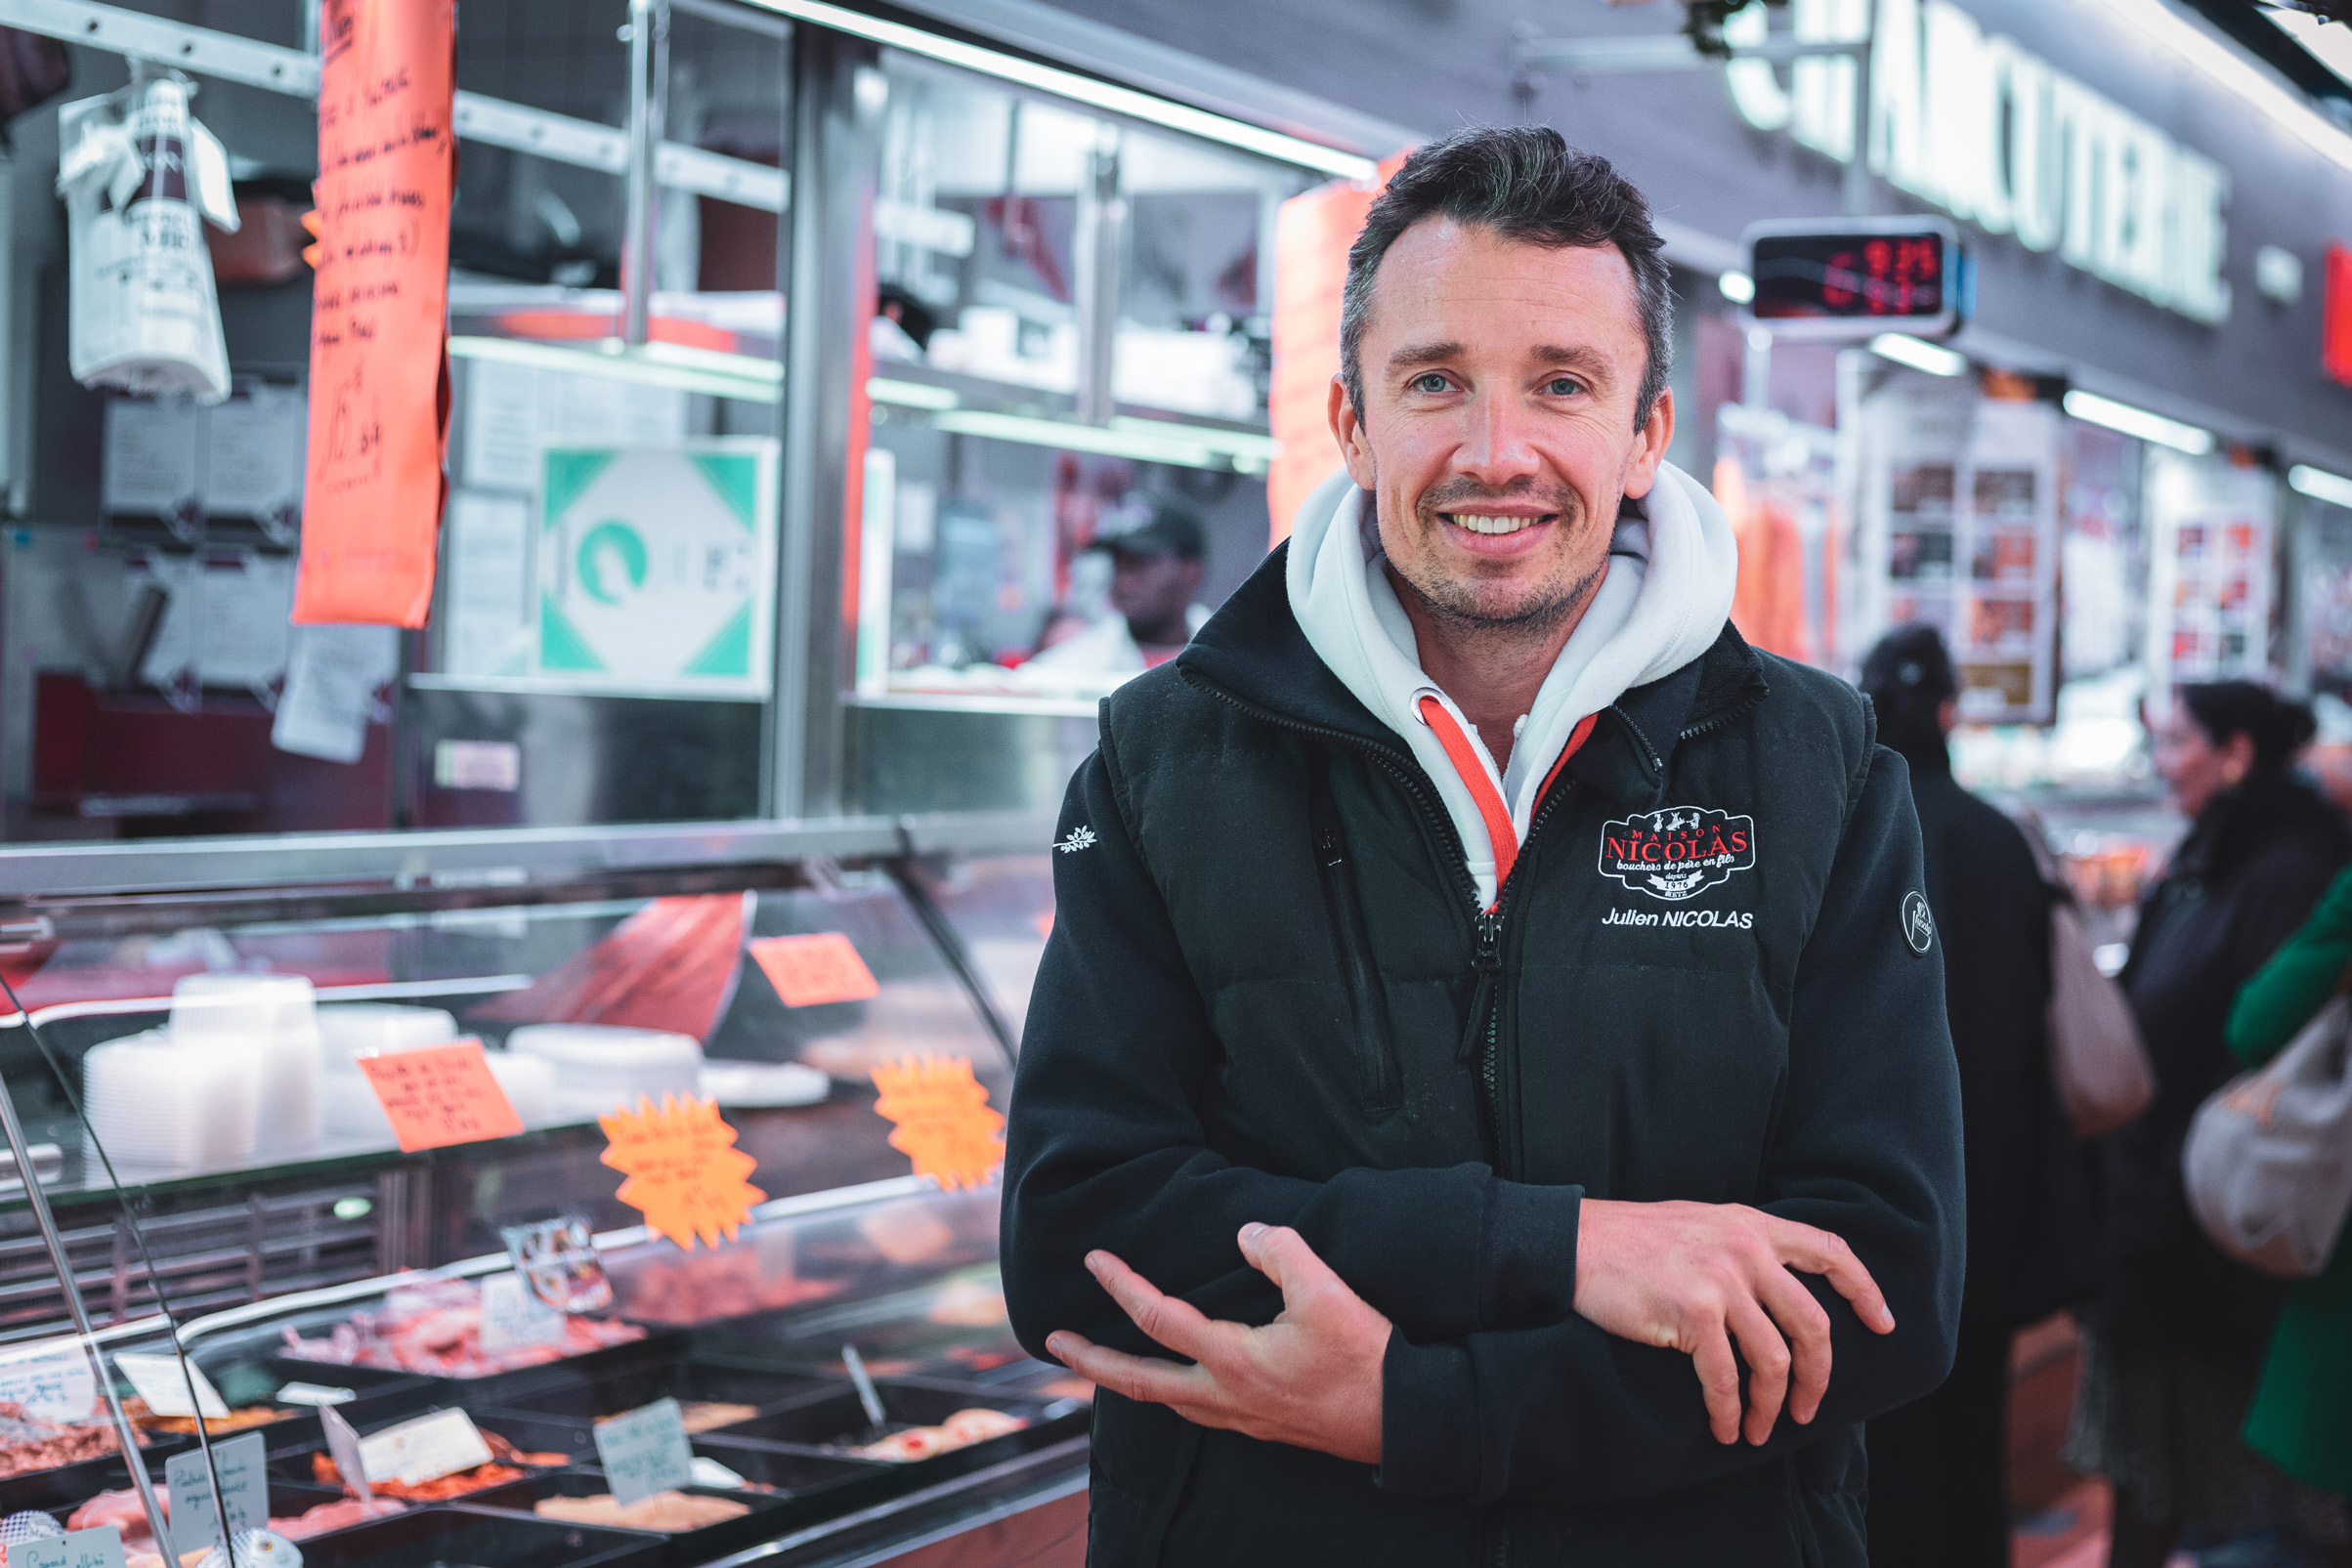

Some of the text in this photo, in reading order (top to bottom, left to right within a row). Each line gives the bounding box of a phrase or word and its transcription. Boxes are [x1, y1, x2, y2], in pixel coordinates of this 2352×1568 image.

[1632, 824, 1721, 841] MAISON
[1605, 830, 1747, 862] NICOLAS
[1616, 859, 1661, 871] bouchers
[1663, 860, 1678, 870] de
[1703, 857, 1716, 867] en
[1716, 853, 1735, 869] fils
[1665, 871, 1688, 881] depuis
[1602, 907, 1754, 929] Julien NICOLAS
